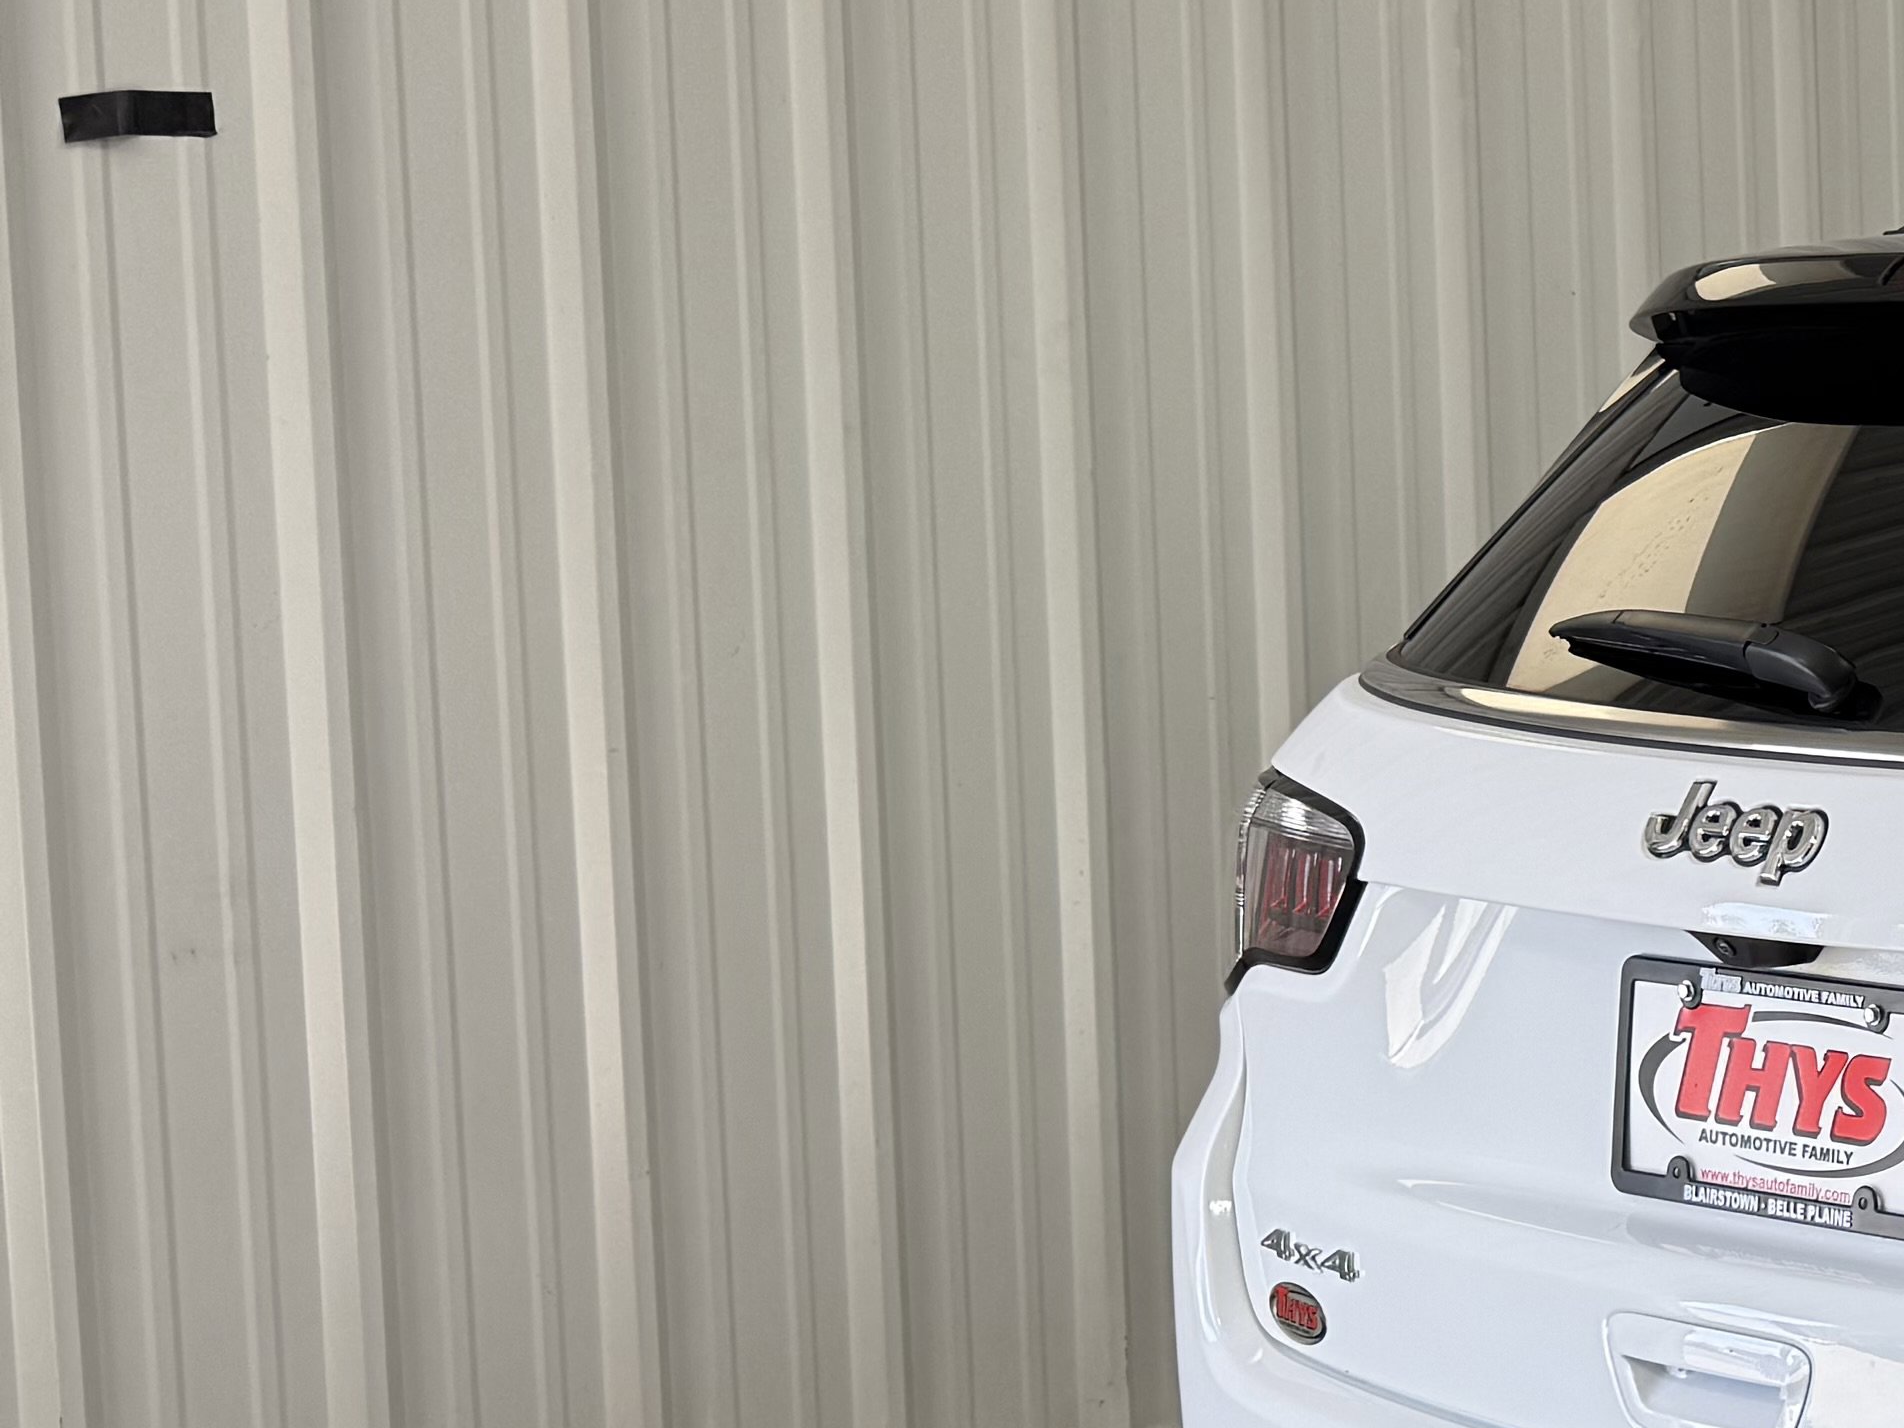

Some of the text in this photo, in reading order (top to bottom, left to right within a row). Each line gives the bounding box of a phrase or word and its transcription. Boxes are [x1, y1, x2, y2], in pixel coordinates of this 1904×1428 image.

[1643, 779, 1830, 887] Jeep
[1743, 981, 1819, 1003] AUTOMOTIVE
[1820, 991, 1864, 1008] FAMILY
[1672, 1002, 1892, 1147] THYS
[1699, 1128, 1854, 1166] AUTOMOTIVE FAMILY
[1683, 1183, 1852, 1228] BLAIRSTOWN BELLE PLAINE
[1700, 1168, 1851, 1204] www.thysautofamily.com
